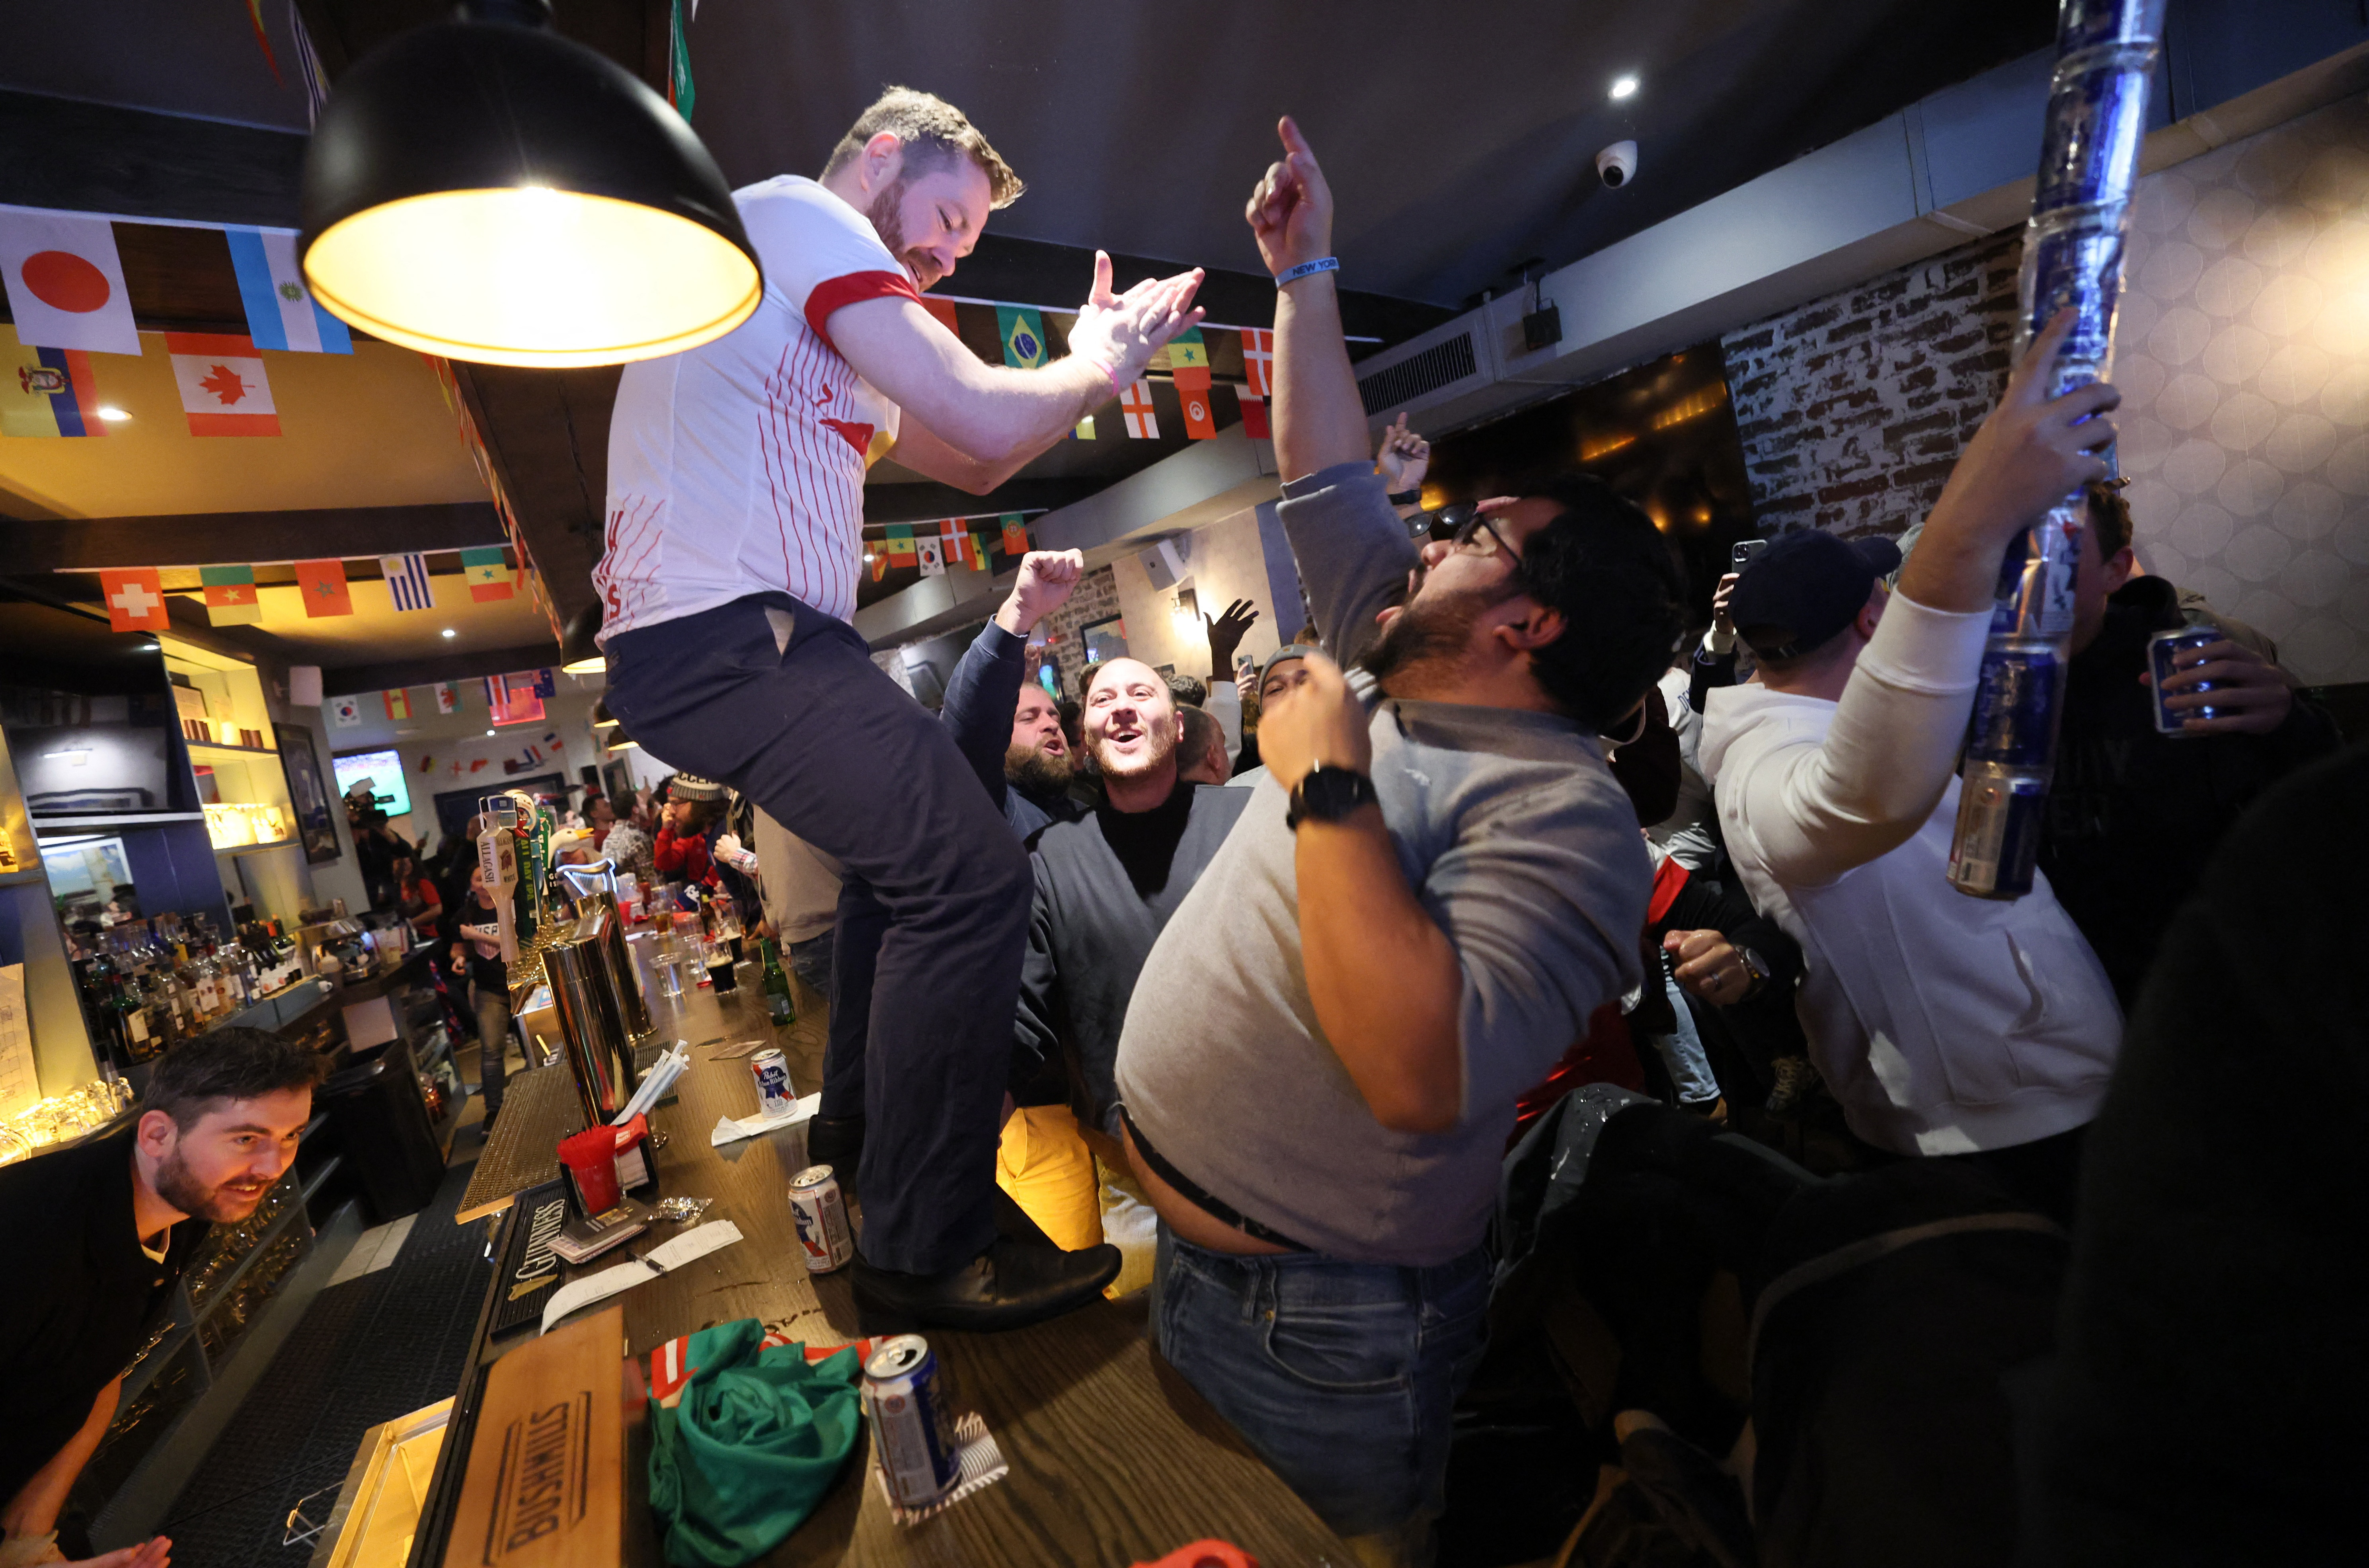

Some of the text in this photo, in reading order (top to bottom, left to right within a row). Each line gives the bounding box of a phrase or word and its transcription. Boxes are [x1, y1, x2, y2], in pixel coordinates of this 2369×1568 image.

[1293, 259, 1336, 275] NEW YOR
[481, 841, 495, 883] ALLAGASH
[523, 861, 532, 880] DAY
[526, 883, 534, 901] IPA
[763, 1070, 778, 1080] Pabst
[770, 1075, 786, 1084] Ribbon
[516, 1199, 565, 1279] GUINNESS
[507, 1402, 569, 1552] BUSHMILLS
